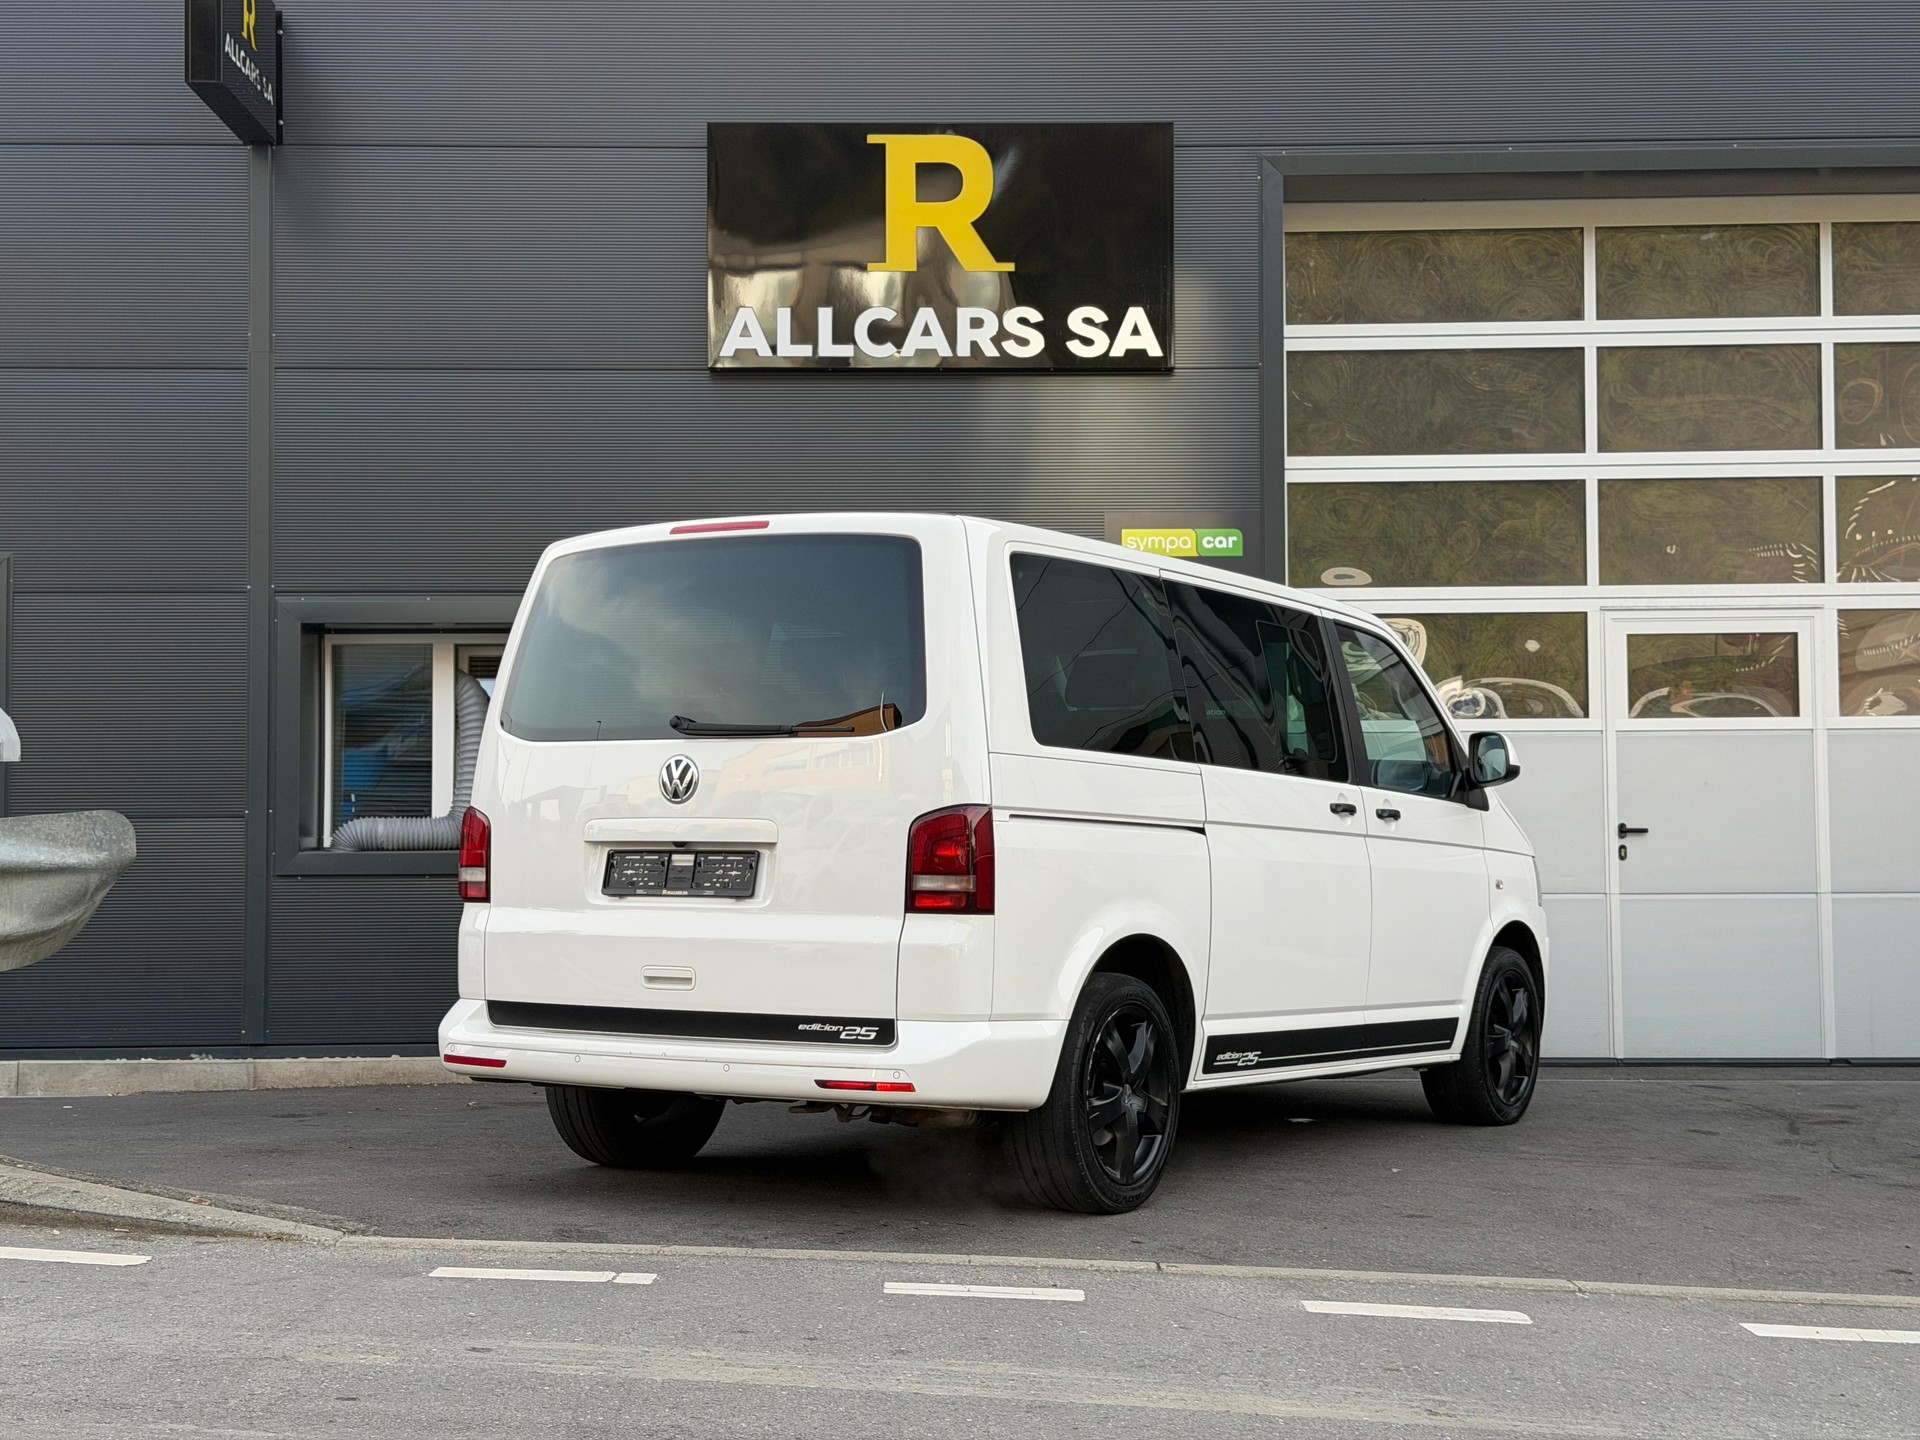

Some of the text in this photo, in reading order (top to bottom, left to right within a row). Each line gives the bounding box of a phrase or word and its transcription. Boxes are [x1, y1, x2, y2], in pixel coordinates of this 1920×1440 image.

[242, 0, 257, 51] R
[225, 32, 273, 106] ALLCARS SA
[867, 134, 1015, 272] R
[719, 306, 1163, 357] ALLCARS SA
[1126, 536, 1238, 553] sympa car
[798, 1023, 879, 1040] edition 25
[1216, 1051, 1261, 1066] edition 25
